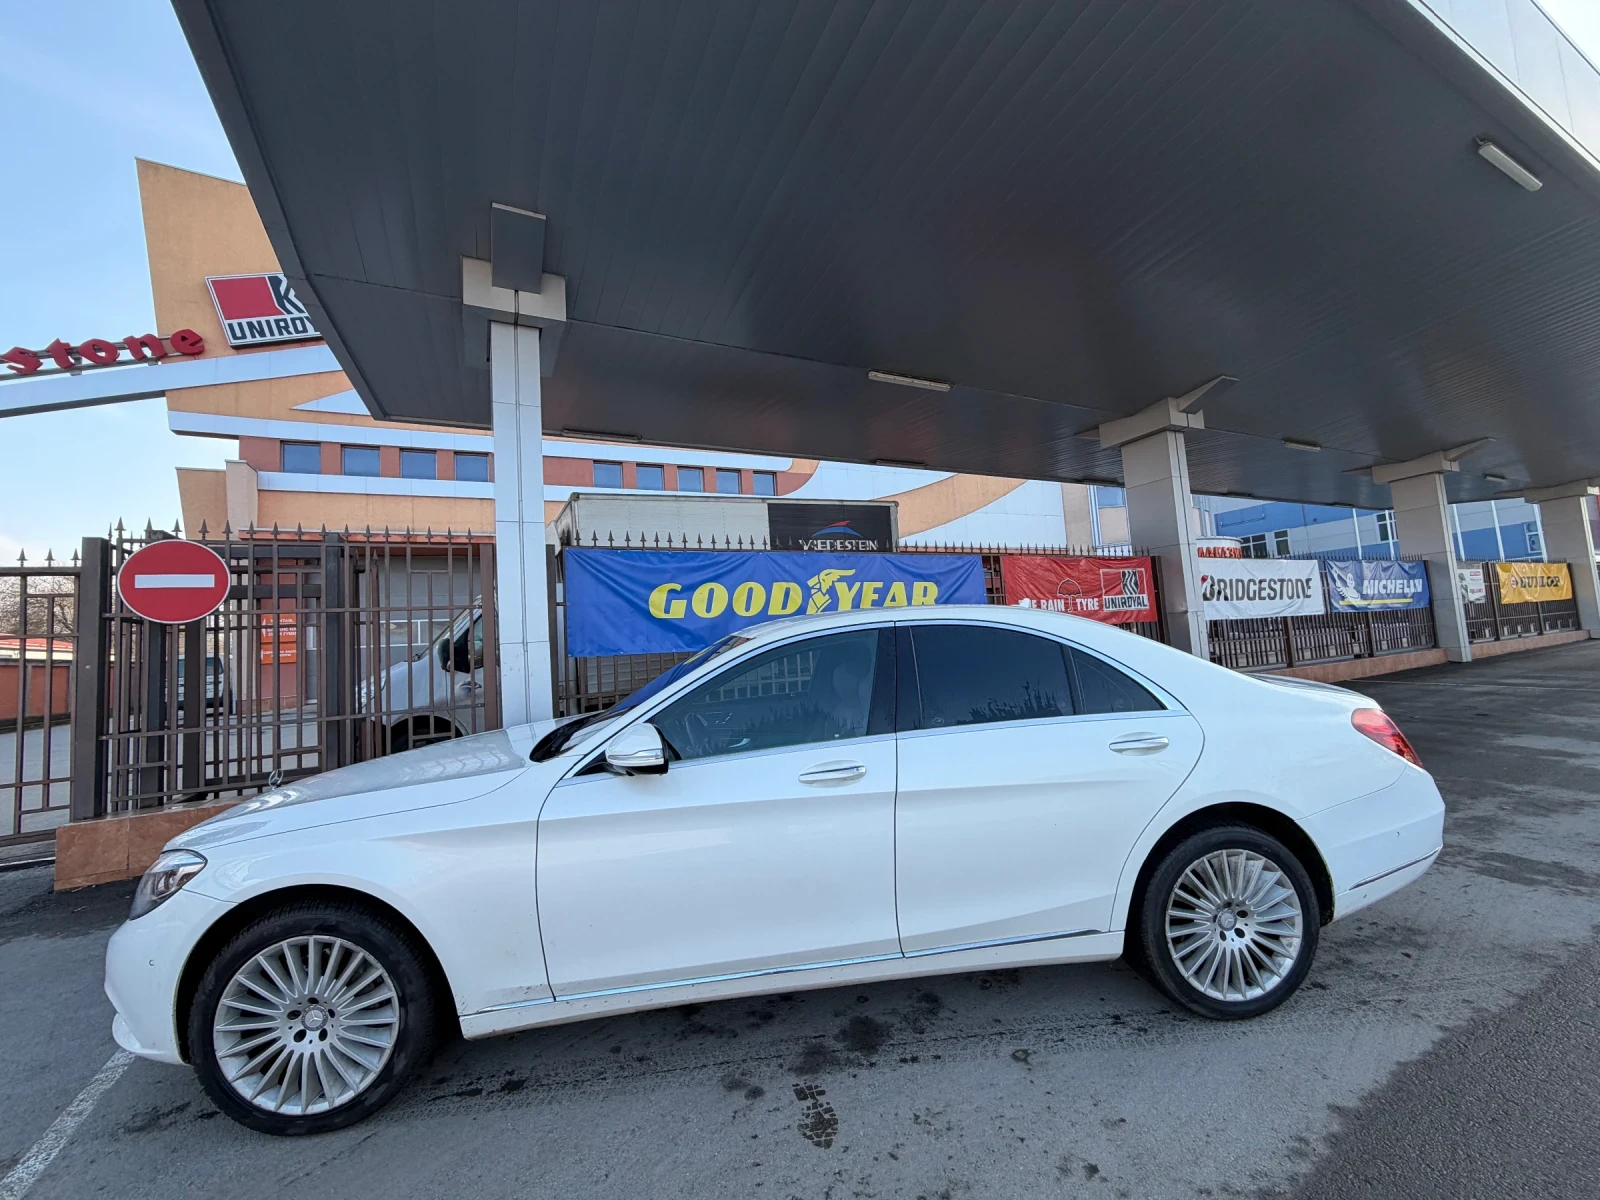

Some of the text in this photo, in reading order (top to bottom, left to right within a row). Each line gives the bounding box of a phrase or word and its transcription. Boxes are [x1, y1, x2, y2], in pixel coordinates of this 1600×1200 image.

[1200, 574, 1313, 602] BRIDGESTONE
[1362, 578, 1423, 595] MICHELIN
[1040, 598, 1065, 612] RAIN
[1075, 598, 1100, 611] TYRE
[1103, 596, 1149, 610] UNIROYAL
